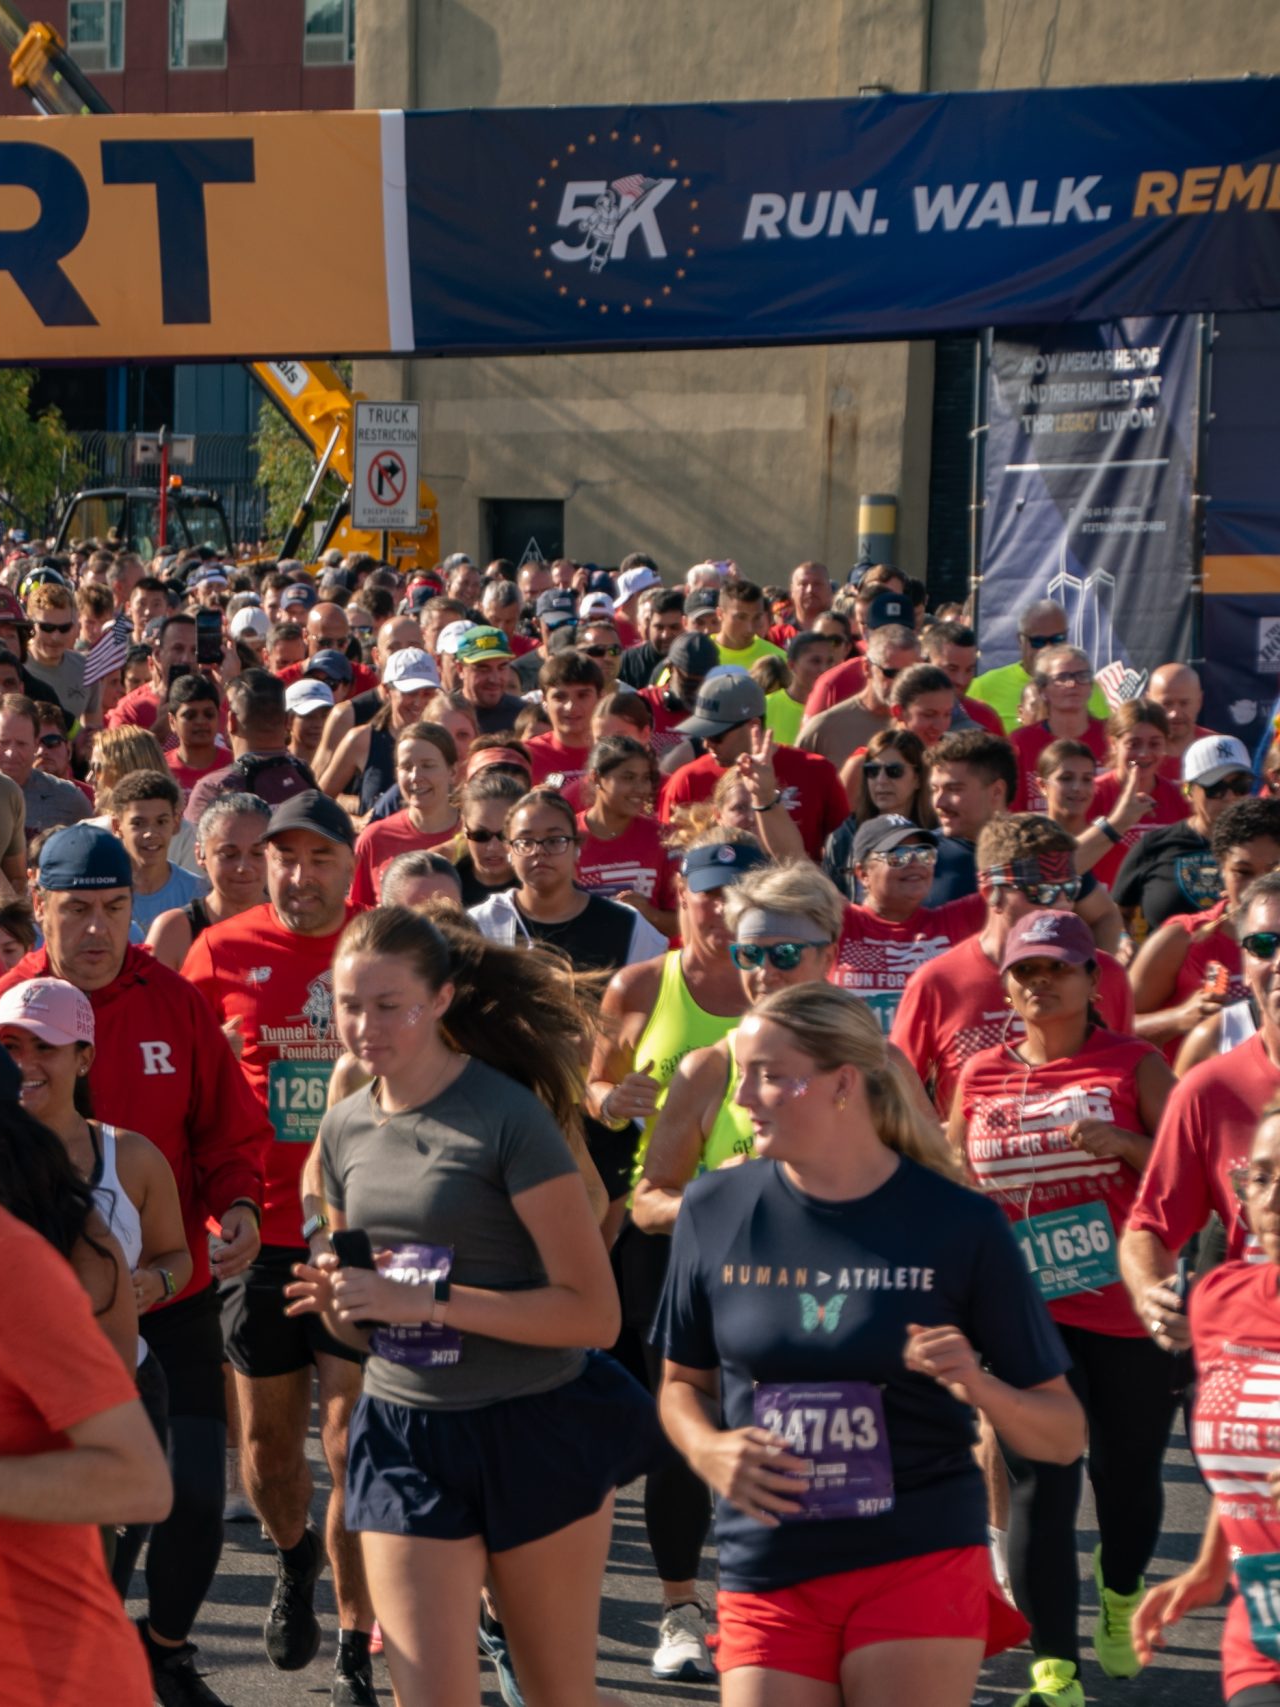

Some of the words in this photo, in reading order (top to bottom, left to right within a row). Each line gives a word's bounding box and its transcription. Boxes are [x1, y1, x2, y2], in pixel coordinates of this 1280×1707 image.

[550, 178, 677, 261] 5K
[742, 188, 889, 240] RUN.
[914, 175, 1112, 233] WALK.
[1131, 375, 1162, 400] TAT
[368, 408, 408, 423] TRUCK
[358, 427, 417, 441] RESTRICTION
[73, 876, 117, 885] FREEDOM
[843, 972, 874, 985] RUN
[878, 973, 907, 988] FOR
[260, 1023, 308, 1041] Tunnel
[139, 1041, 176, 1076] R
[275, 1077, 331, 1110] 126
[972, 1138, 1003, 1159] RUN
[1007, 1132, 1043, 1155] FOR
[1018, 1219, 1110, 1274] 11636
[723, 1264, 809, 1287] HUMAN
[837, 1266, 936, 1292] ATHLETE
[762, 1406, 879, 1456] 34743
[1218, 1421, 1259, 1451] FOR
